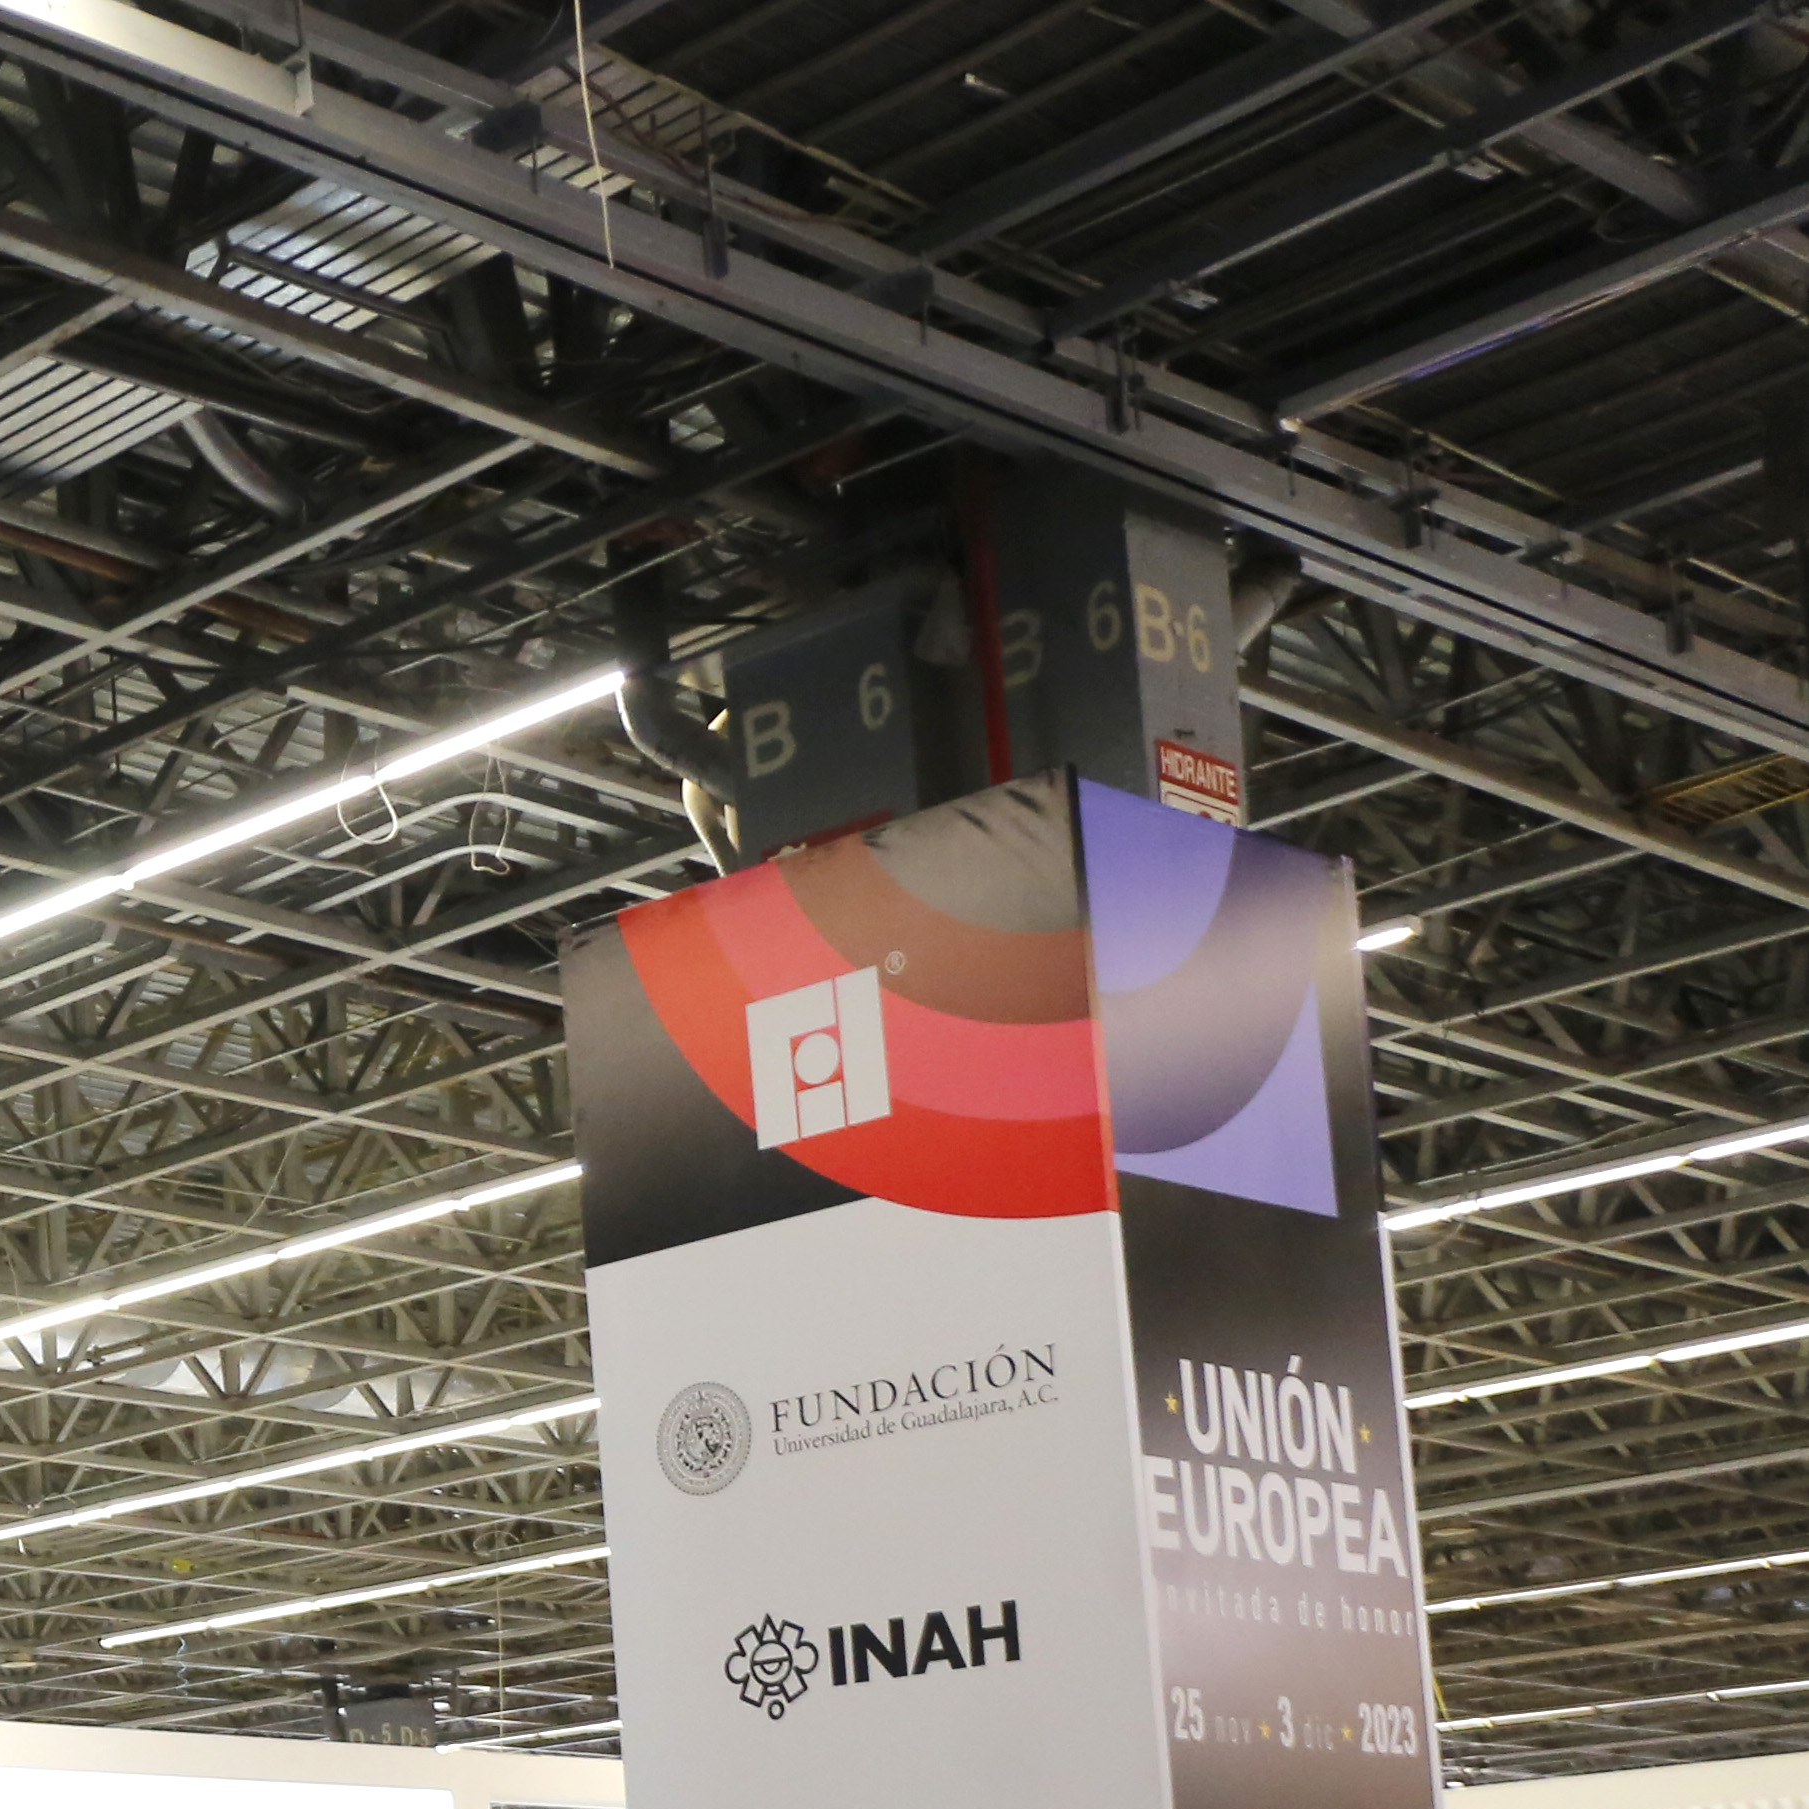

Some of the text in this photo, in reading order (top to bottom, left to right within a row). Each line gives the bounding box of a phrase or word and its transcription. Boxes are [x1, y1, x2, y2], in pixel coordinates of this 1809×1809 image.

[741, 664, 891, 778] B 6
[1159, 746, 1237, 798] HIDRANTE
[769, 1342, 1059, 1434] FUNDACIÓN
[772, 1385, 1059, 1457] Universidad de Guadalajara, A.C.
[1179, 1354, 1357, 1475] UNIÓN
[1142, 1454, 1410, 1578] EUROPEA
[828, 1599, 1022, 1687] INAH
[1166, 1580, 1280, 1624] nvitada
[1297, 1591, 1326, 1629] de
[1170, 1685, 1205, 1741] 25
[1277, 1695, 1295, 1748] 3
[1358, 1702, 1418, 1757] 2023
